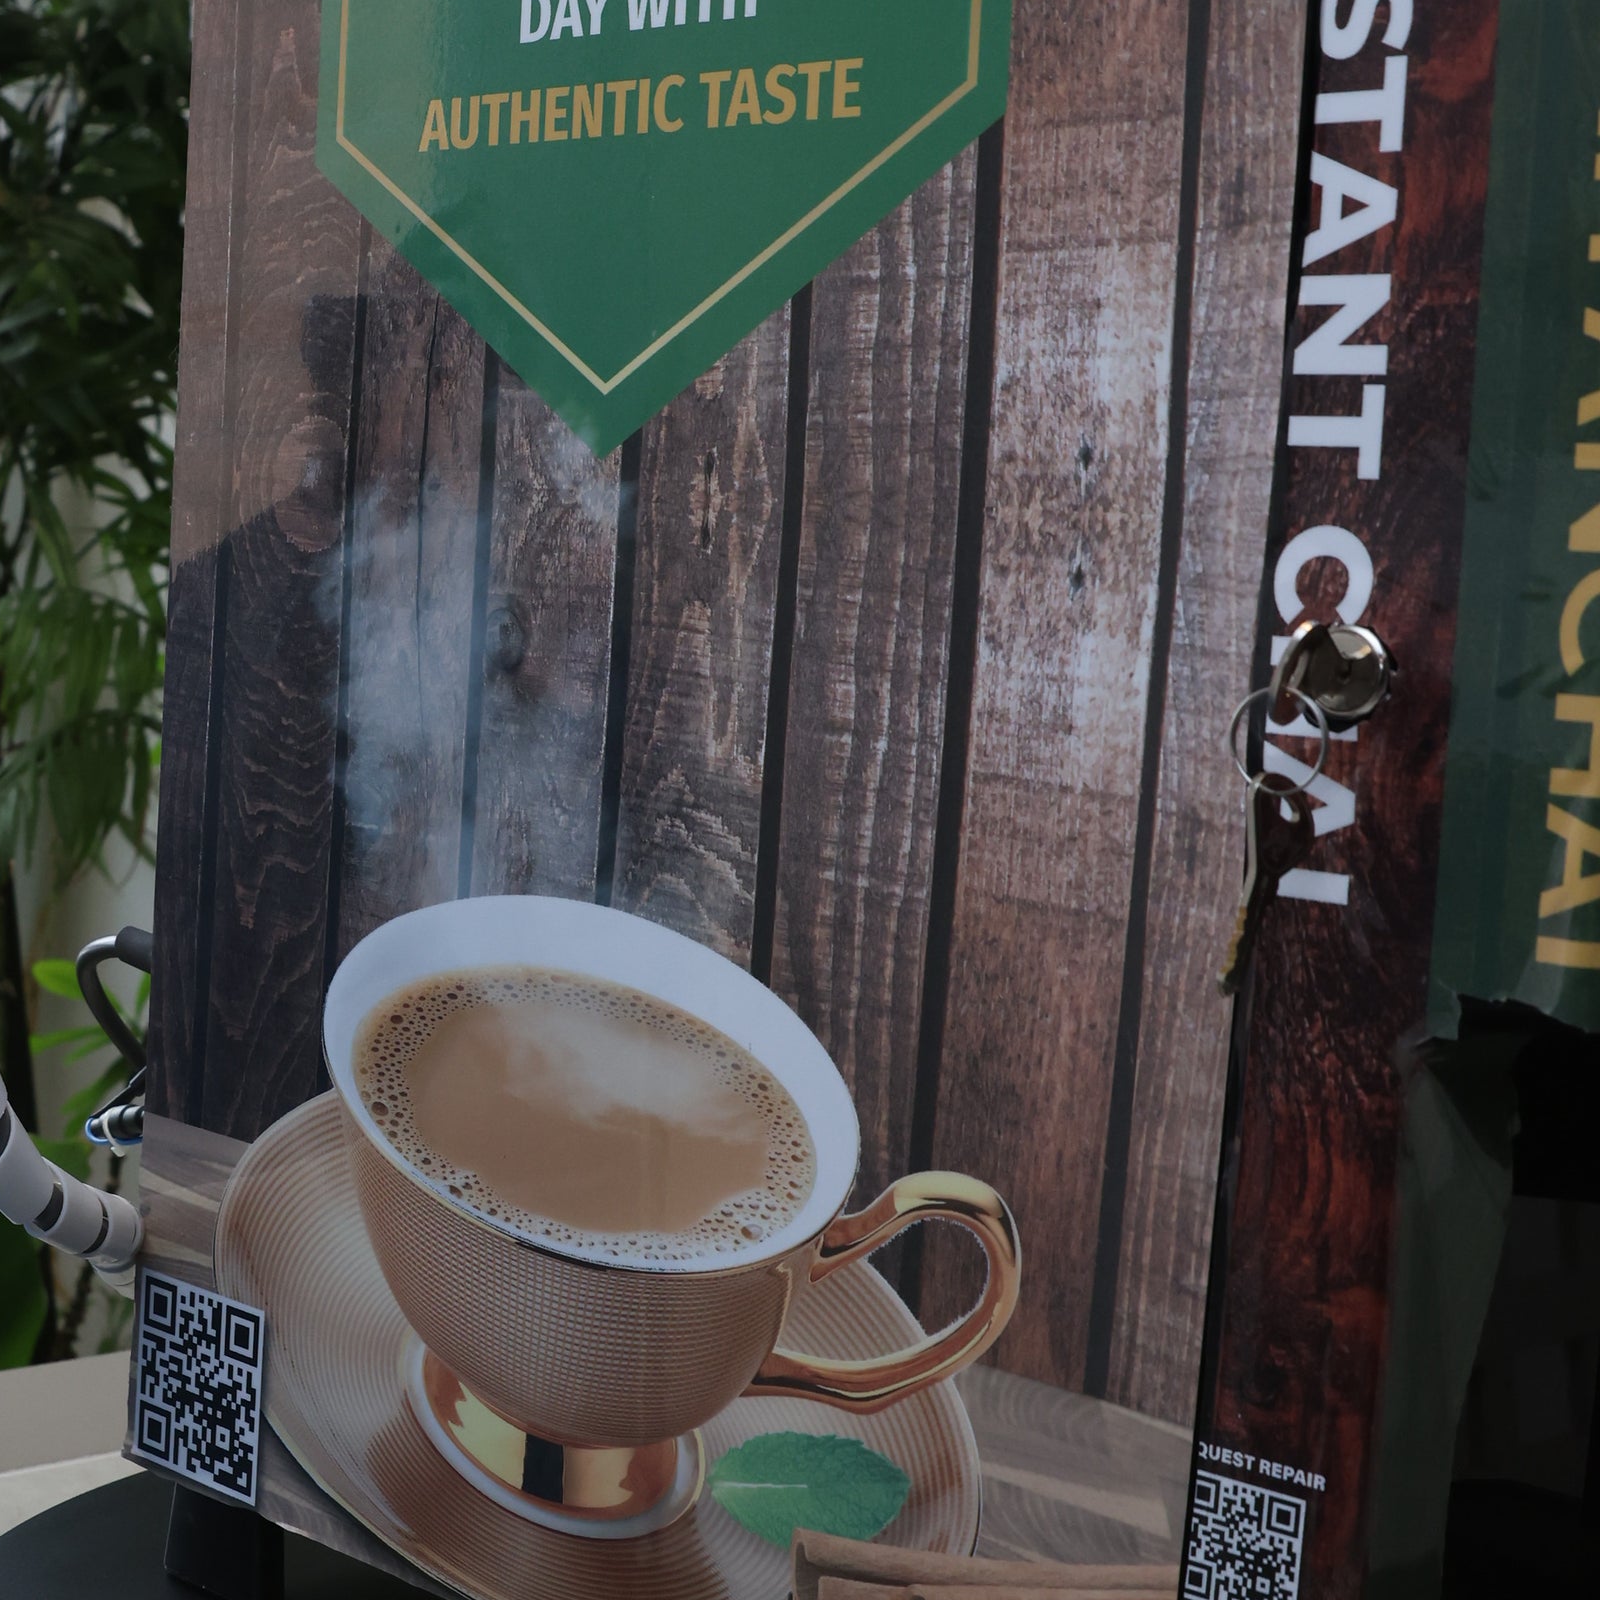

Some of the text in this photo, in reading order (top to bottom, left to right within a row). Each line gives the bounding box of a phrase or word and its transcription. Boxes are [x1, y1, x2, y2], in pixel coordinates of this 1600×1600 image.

[418, 57, 864, 153] AUTHENTIC TASTE
[1259, 1458, 1327, 1492] REPAIR
